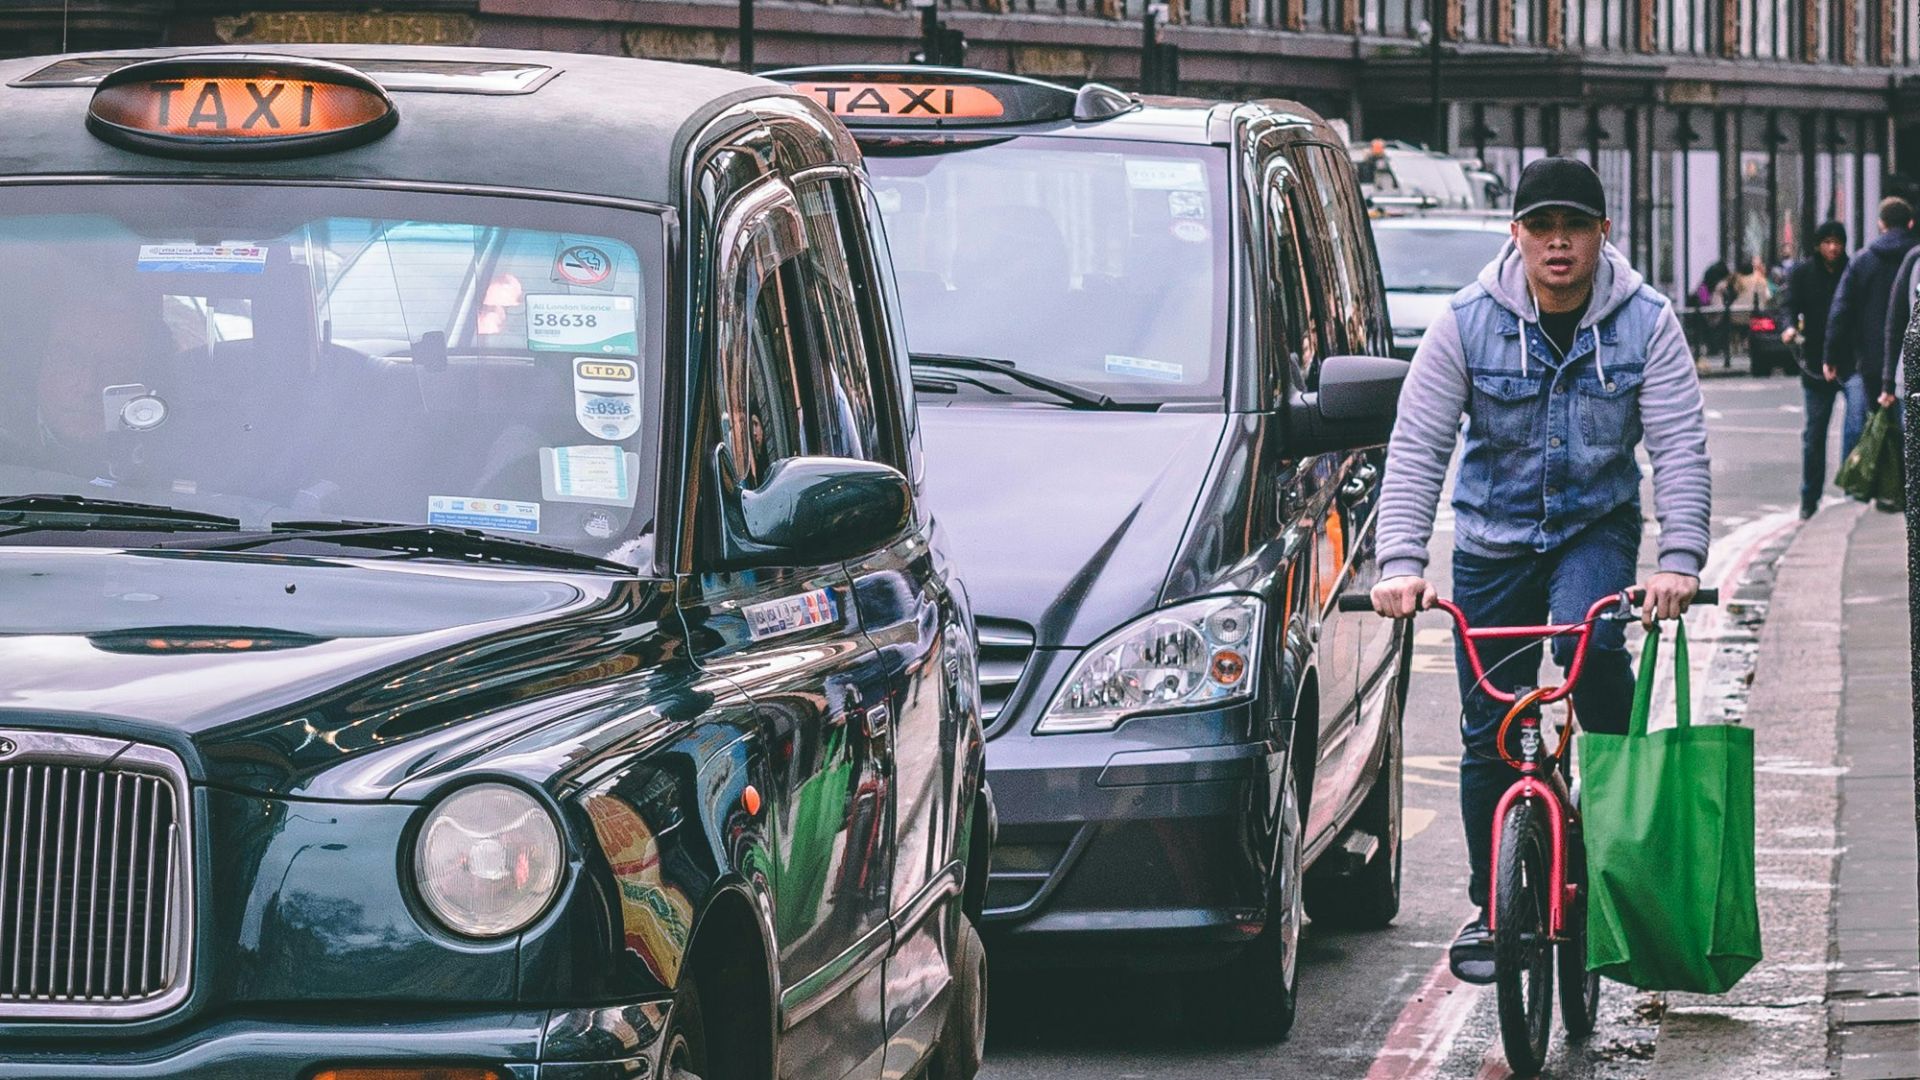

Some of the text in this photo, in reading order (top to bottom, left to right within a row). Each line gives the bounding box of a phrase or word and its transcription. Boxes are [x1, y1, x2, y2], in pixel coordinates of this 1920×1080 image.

[152, 81, 314, 129] TAXI
[814, 86, 955, 115] TAXI
[546, 303, 579, 311] London
[580, 304, 612, 312] licence
[533, 313, 598, 328] 58638
[585, 366, 627, 377] LTDA
